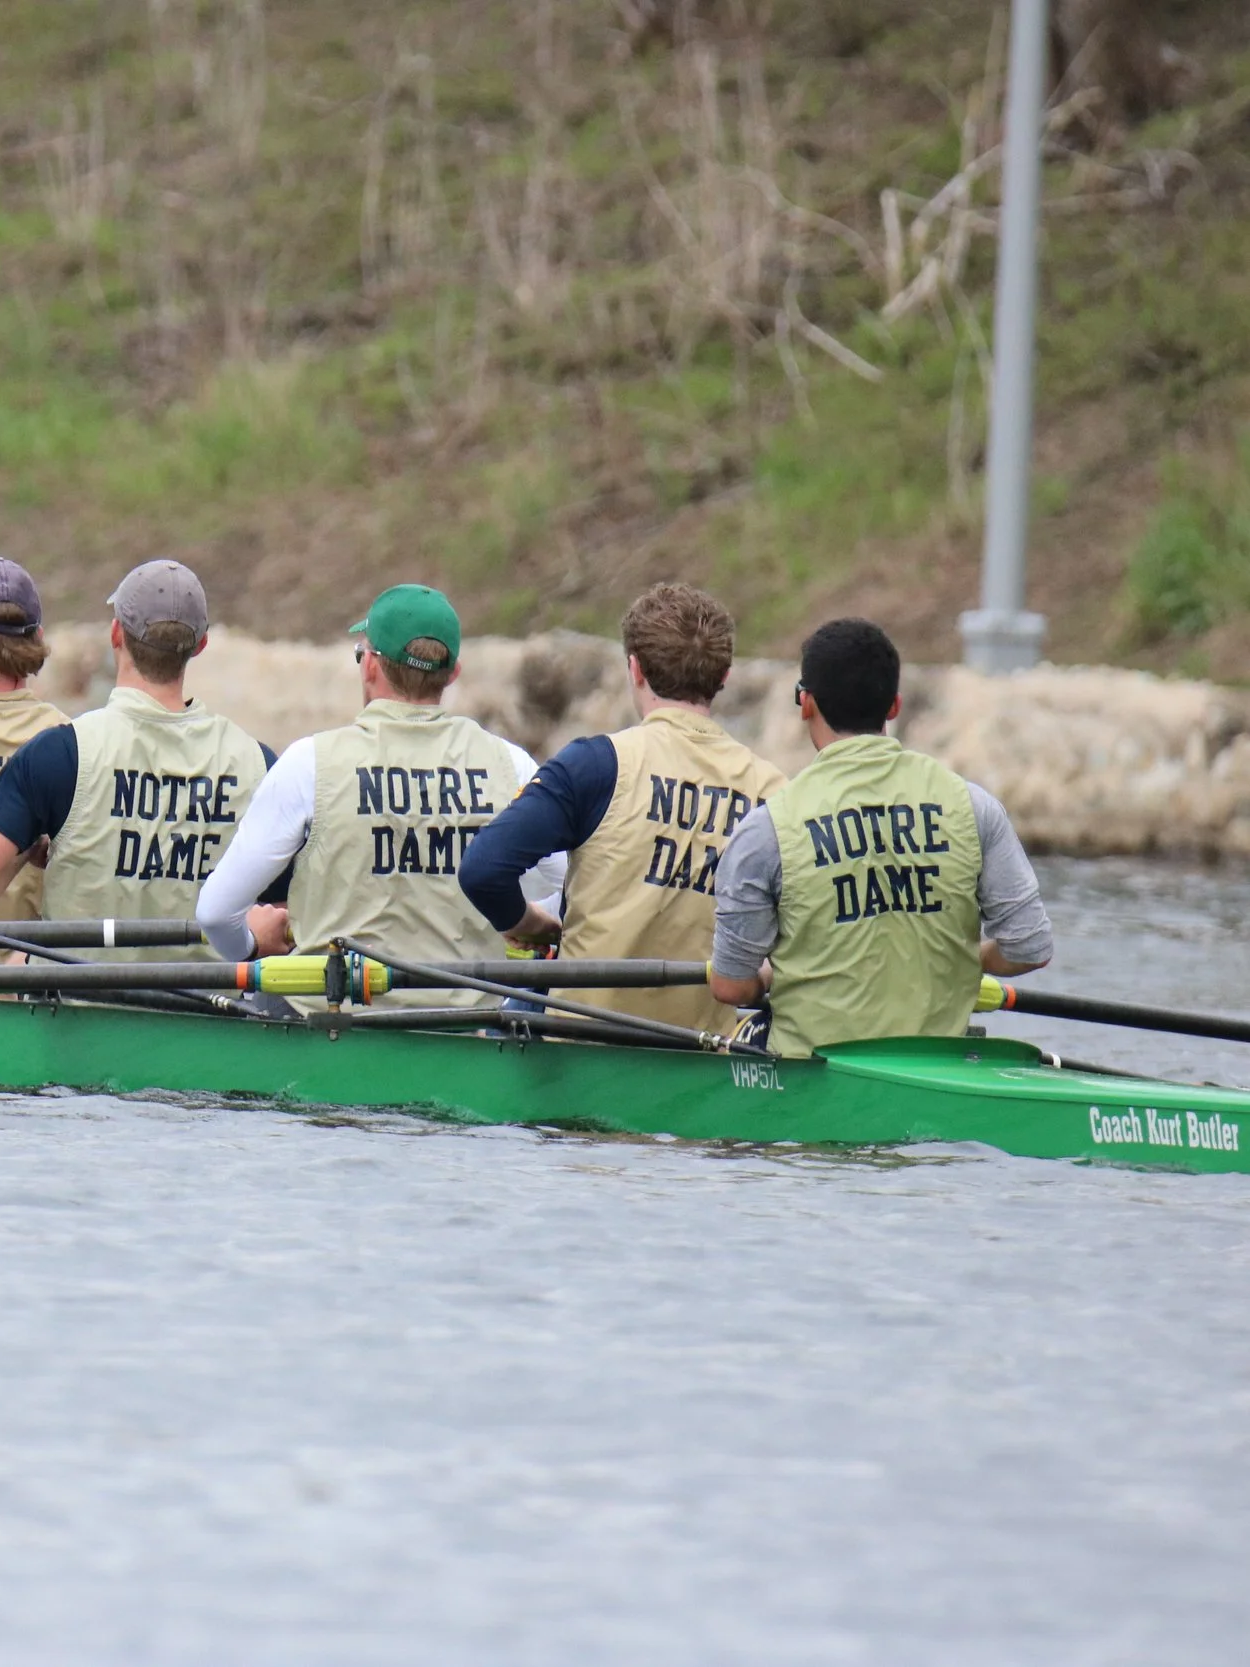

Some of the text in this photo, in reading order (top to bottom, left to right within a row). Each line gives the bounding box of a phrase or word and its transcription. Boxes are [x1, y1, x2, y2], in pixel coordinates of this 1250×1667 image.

[110, 769, 238, 823] NOTRE
[356, 766, 494, 815] NOTRE
[646, 774, 767, 837] NOTR
[115, 829, 221, 881] DAME
[805, 802, 949, 867] NOTRE
[644, 835, 725, 896] DAM
[832, 865, 942, 923] DAME
[1089, 1106, 1239, 1151] Coach Kurt Butler
